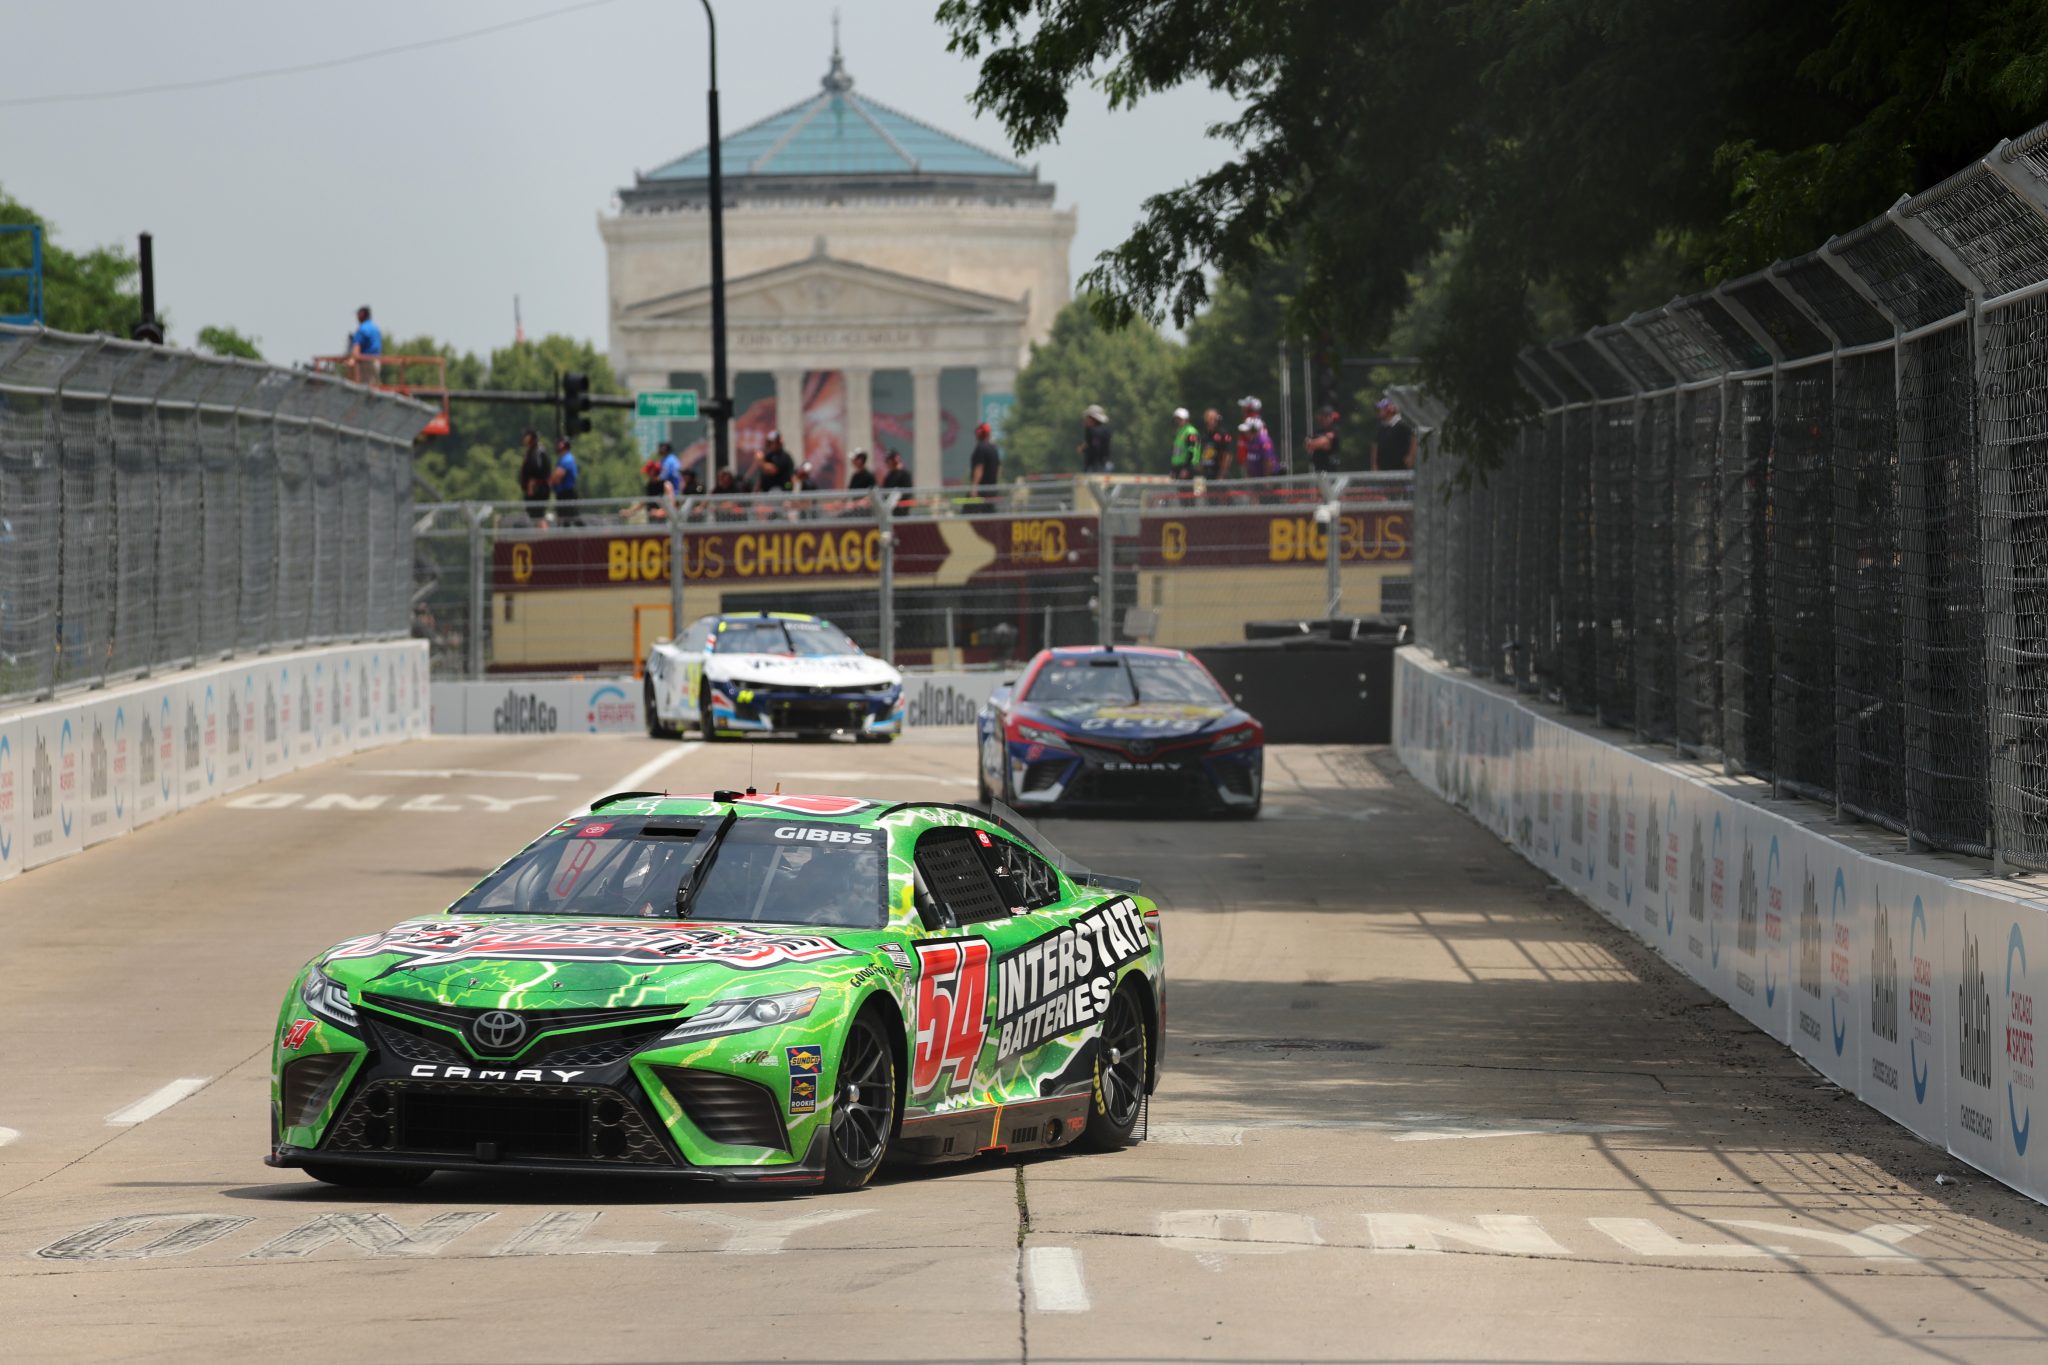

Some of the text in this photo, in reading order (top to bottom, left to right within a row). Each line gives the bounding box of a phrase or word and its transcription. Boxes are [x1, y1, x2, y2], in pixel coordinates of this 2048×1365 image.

[734, 529, 882, 577] CHICAGO
[494, 688, 557, 733] CHICAGO
[908, 680, 976, 726] CHICAGO
[226, 792, 558, 813] ONLY
[775, 826, 873, 845] GIBBS
[850, 963, 896, 988] GOODYEAR
[998, 898, 1150, 1020] INTERSTATE
[912, 940, 991, 1095] 54
[1959, 911, 1992, 1090] CHICAGO
[2011, 990, 2033, 1026] CHICAGO
[281, 1019, 318, 1050] 54
[2012, 1029, 2034, 1069] SPORTS
[411, 1064, 585, 1083] CAMRY
[791, 1056, 820, 1066] SUNOCO
[791, 1100, 815, 1108] ROOKIE
[1960, 1104, 1993, 1142] CHOOSE CHICAGO
[33, 1210, 878, 1261] ONLY
[1155, 1209, 1930, 1262] ONLY
